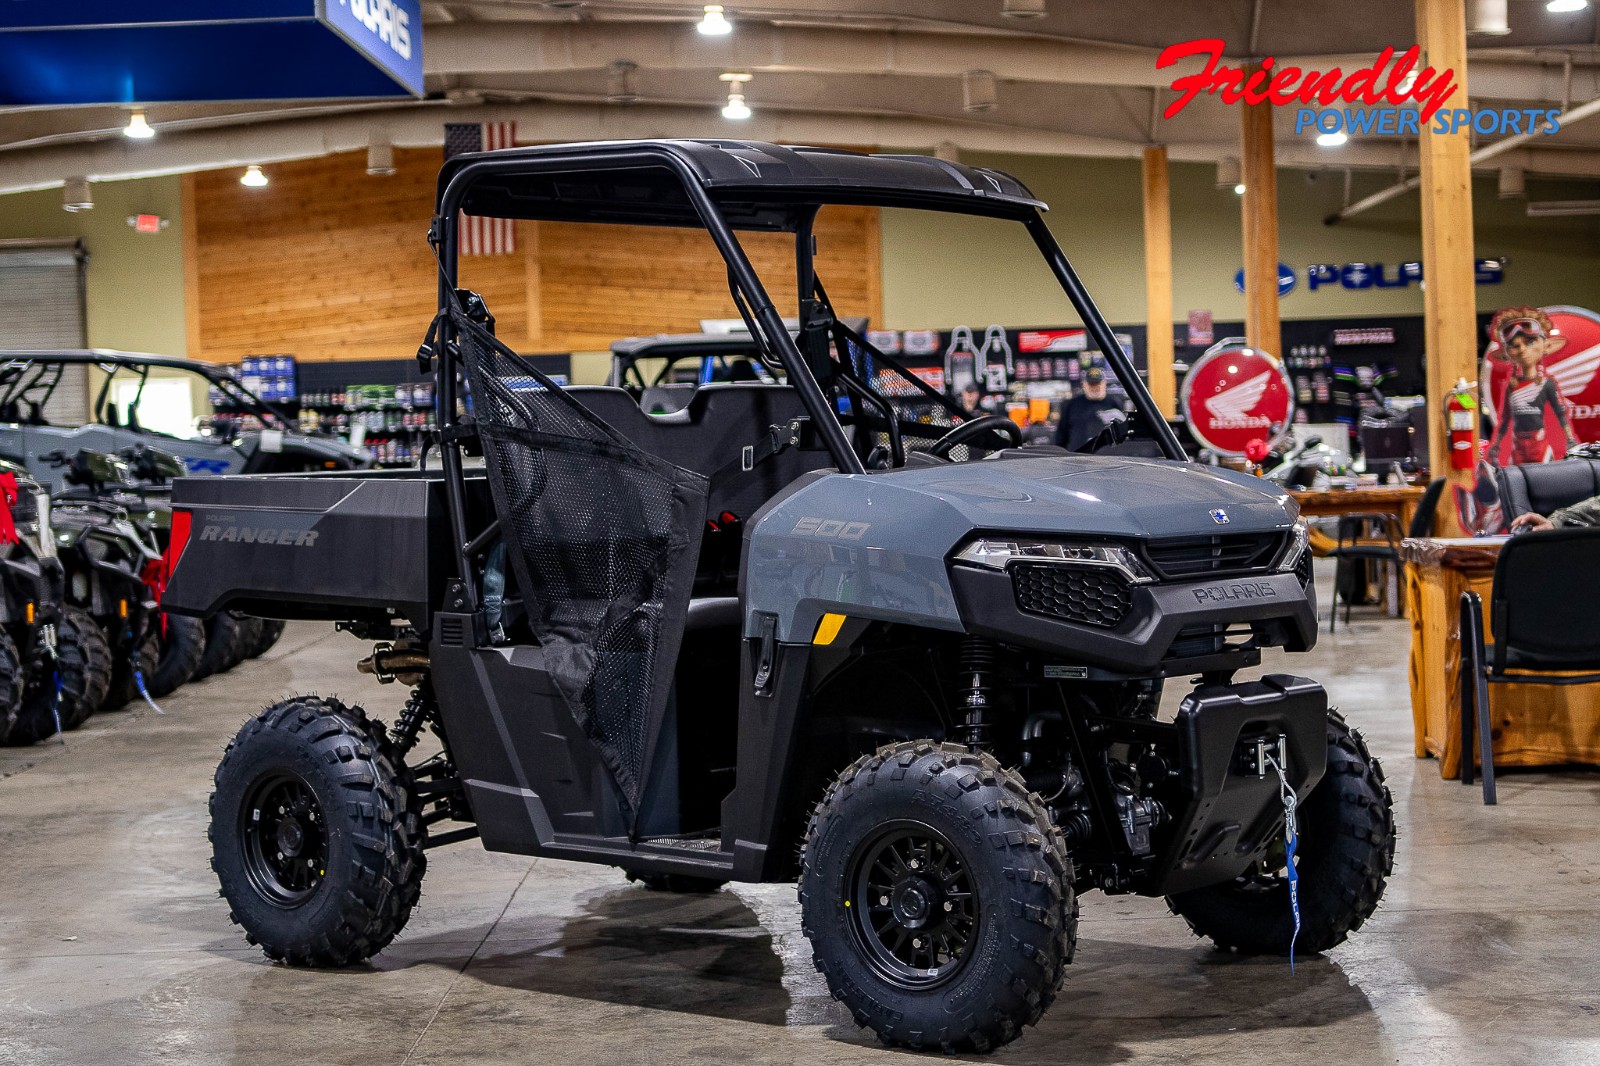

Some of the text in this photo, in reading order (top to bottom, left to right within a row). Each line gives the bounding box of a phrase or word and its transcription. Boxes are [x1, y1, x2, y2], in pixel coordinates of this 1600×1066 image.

[339, 0, 412, 60] LARIS
[1308, 261, 1504, 291] POLAS
[1208, 414, 1272, 430] HONDA
[199, 525, 320, 548] RANGER
[790, 516, 871, 540] 500
[1191, 582, 1276, 604] POLARIS
